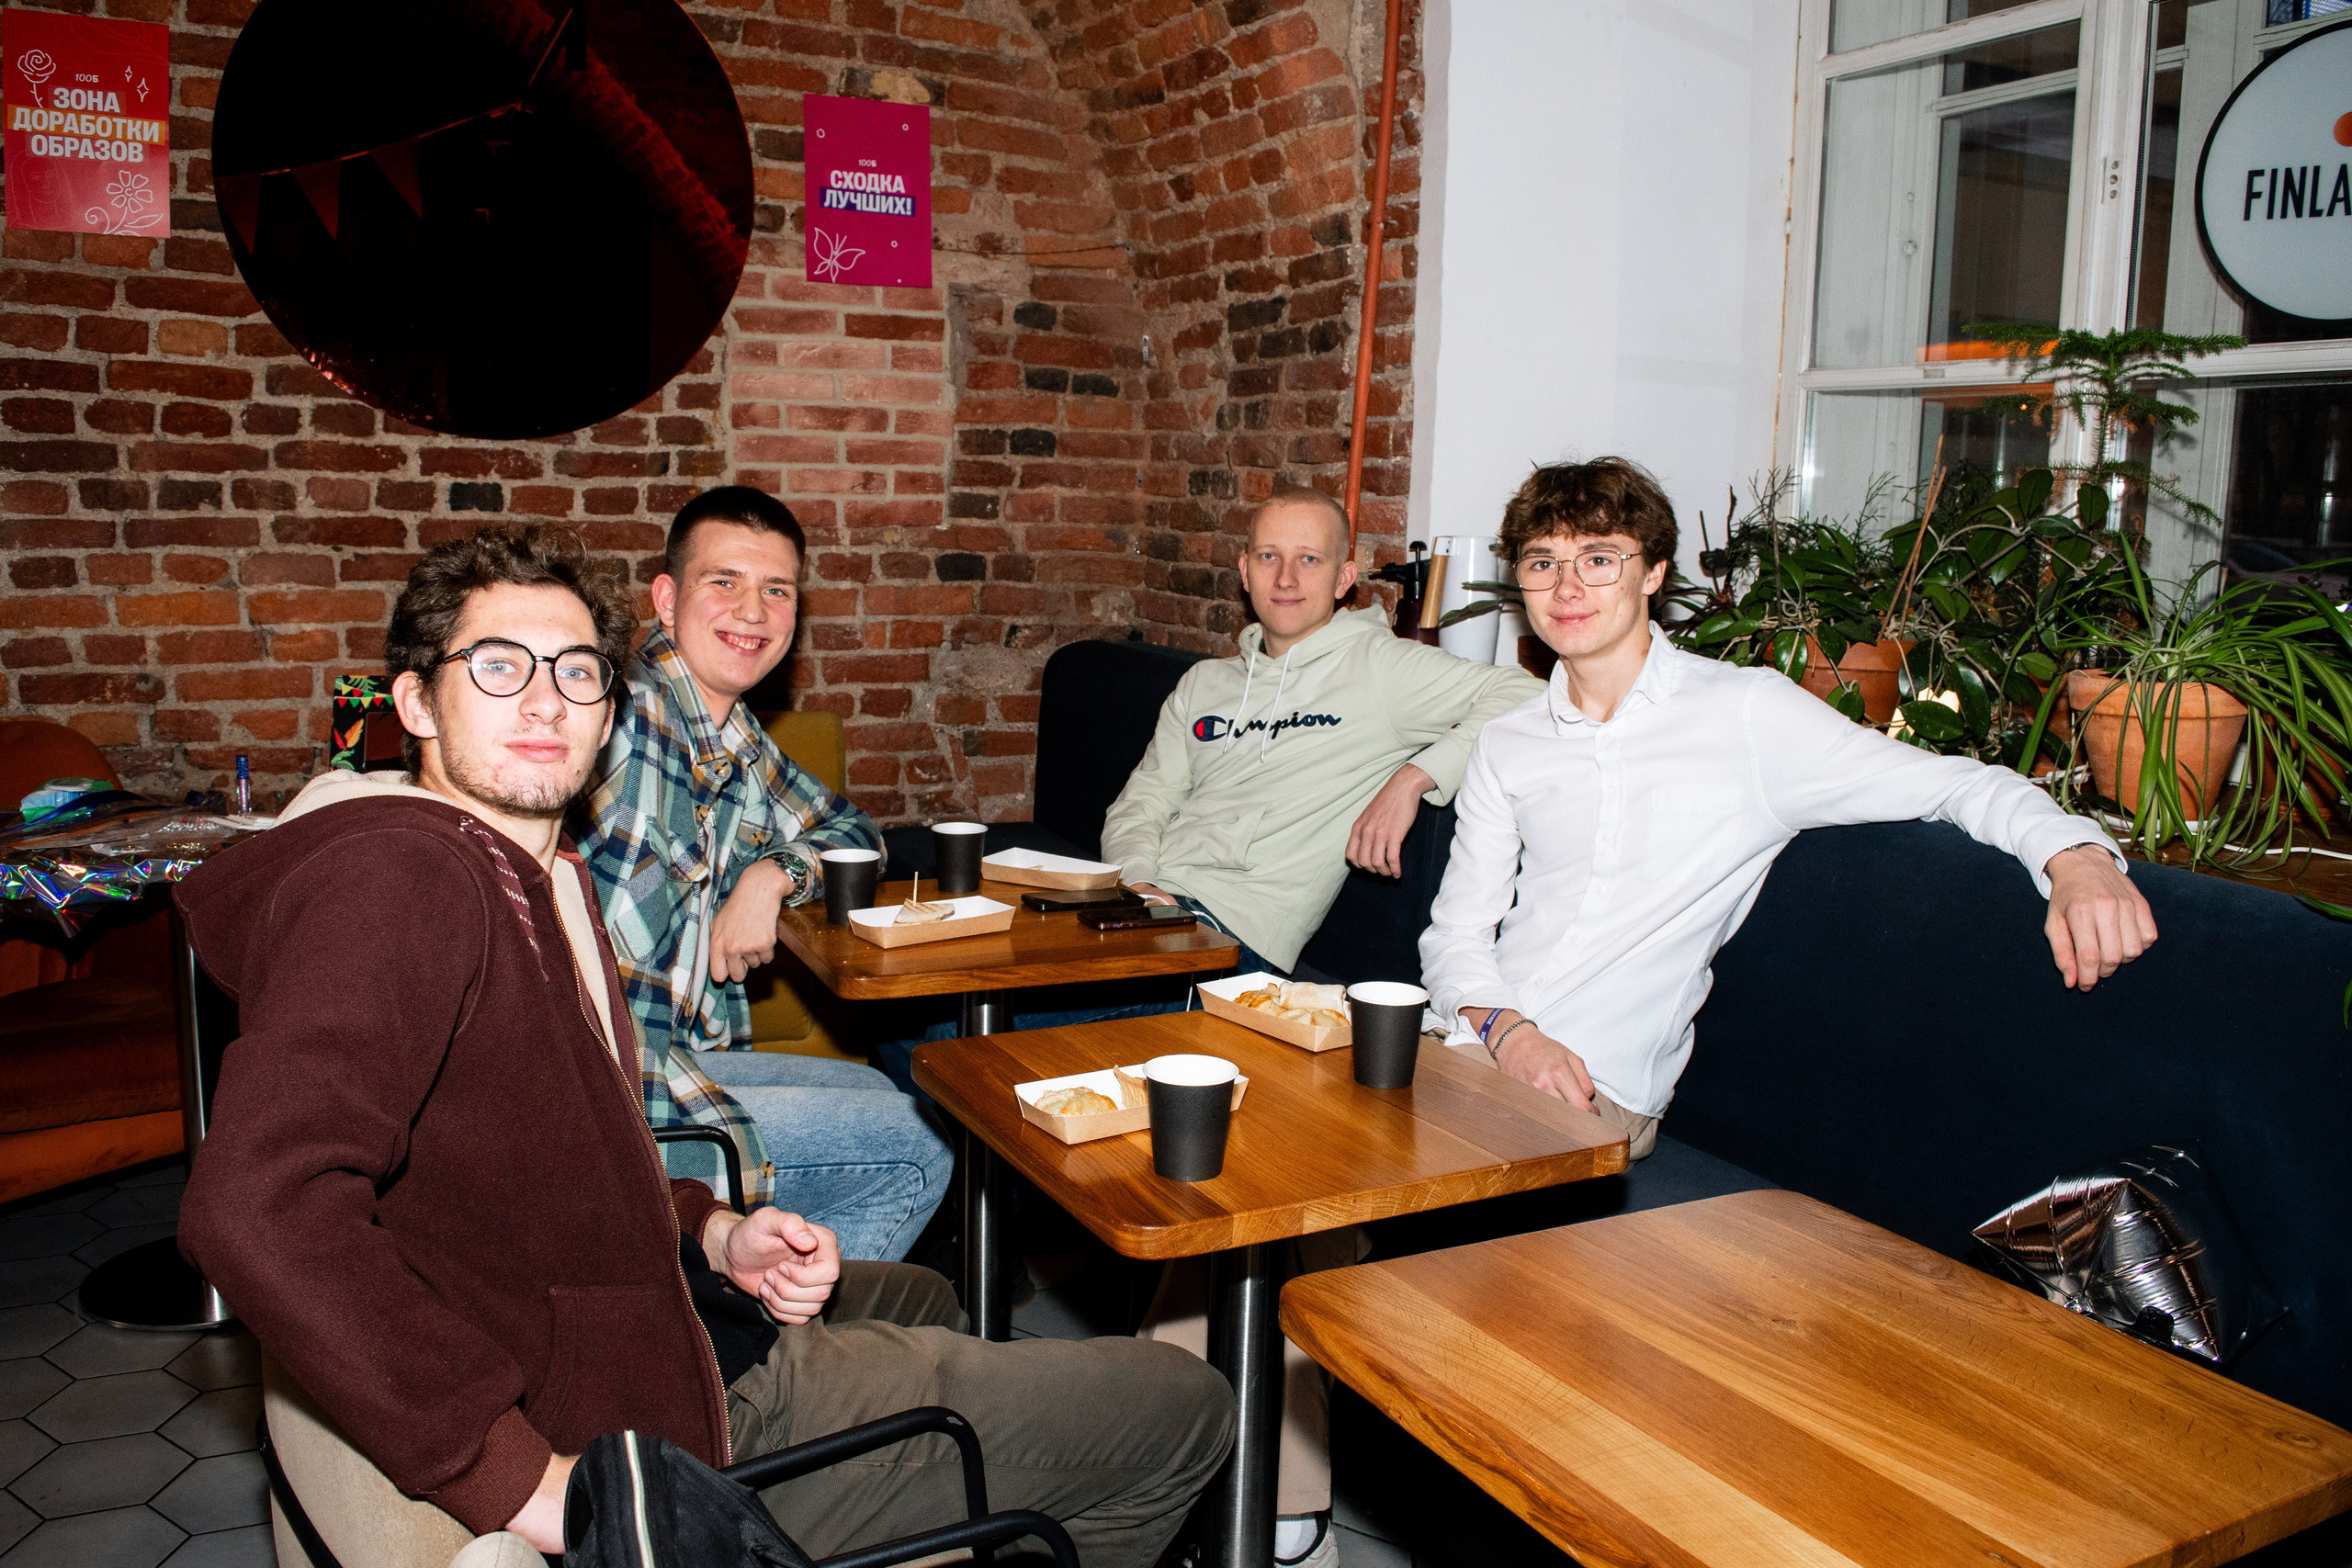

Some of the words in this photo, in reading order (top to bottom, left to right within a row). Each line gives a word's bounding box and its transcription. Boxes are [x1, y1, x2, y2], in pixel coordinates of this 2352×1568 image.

[75, 73, 99, 84] 100Б
[53, 87, 120, 113] ЗОНА
[13, 107, 160, 143] ДОРАБОТКИ
[31, 135, 143, 163] ОБРАЗОВ
[858, 159, 877, 168] 100Б
[830, 170, 906, 194] СХОДКА
[823, 189, 912, 216] ЛУЧШИХ!
[1193, 712, 1341, 742] Chmpion
